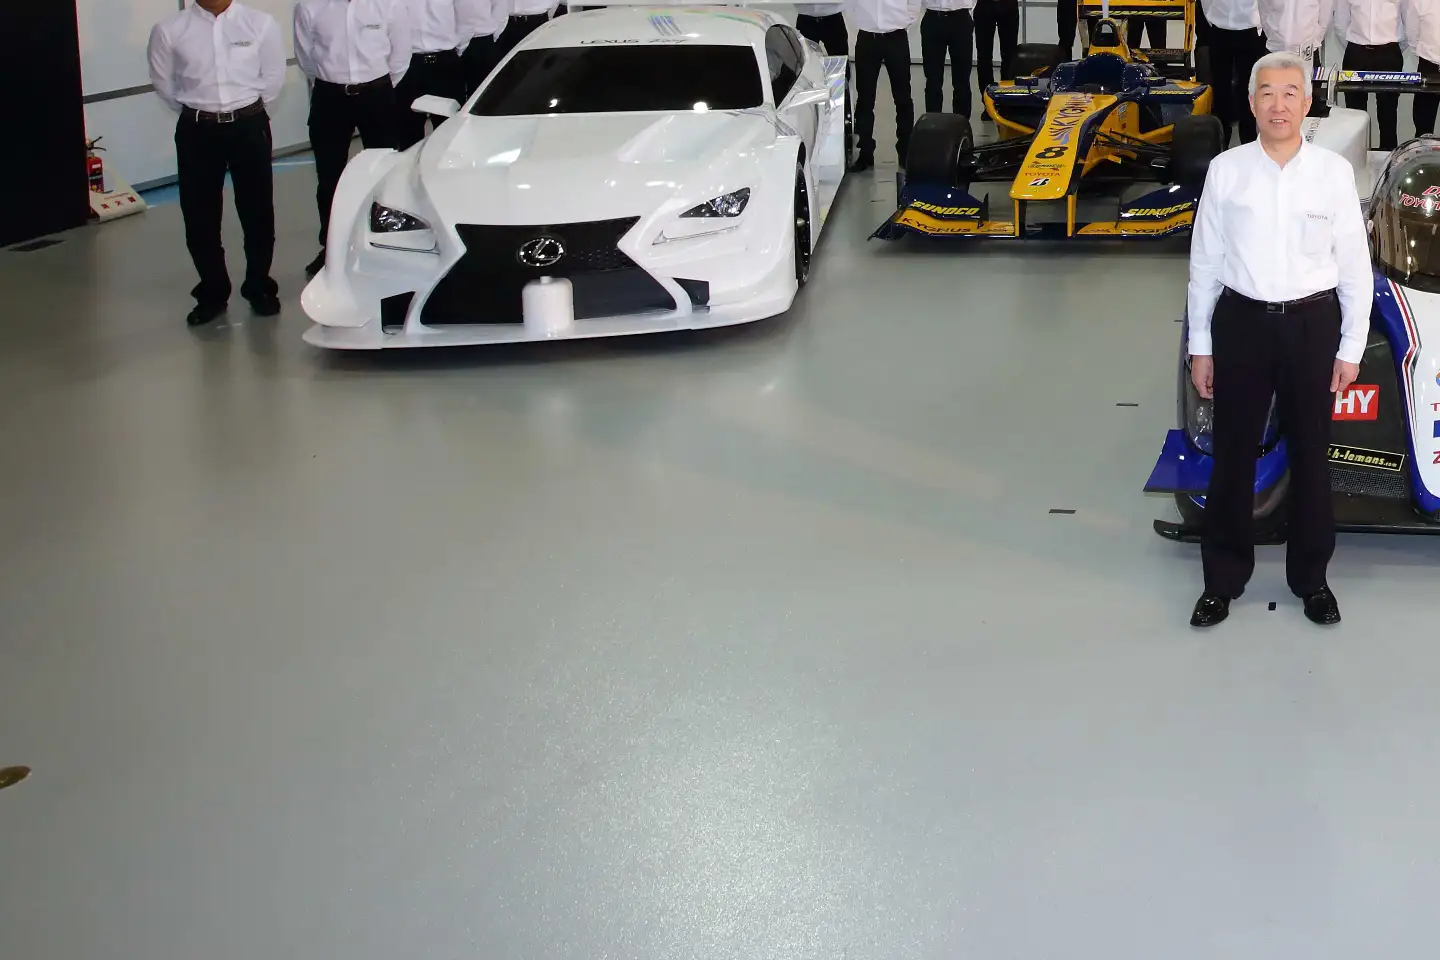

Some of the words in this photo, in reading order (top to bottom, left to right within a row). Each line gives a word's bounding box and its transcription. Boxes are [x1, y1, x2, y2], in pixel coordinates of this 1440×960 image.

[1363, 73, 1421, 81] MICHELIN
[1035, 146, 1069, 159] 8
[911, 201, 980, 216] SUNOCO
[1127, 202, 1193, 216] SUNOCO
[902, 218, 971, 232] KYGNUS
[1334, 390, 1376, 414] HY
[1327, 447, 1398, 468] h-lemans.com
